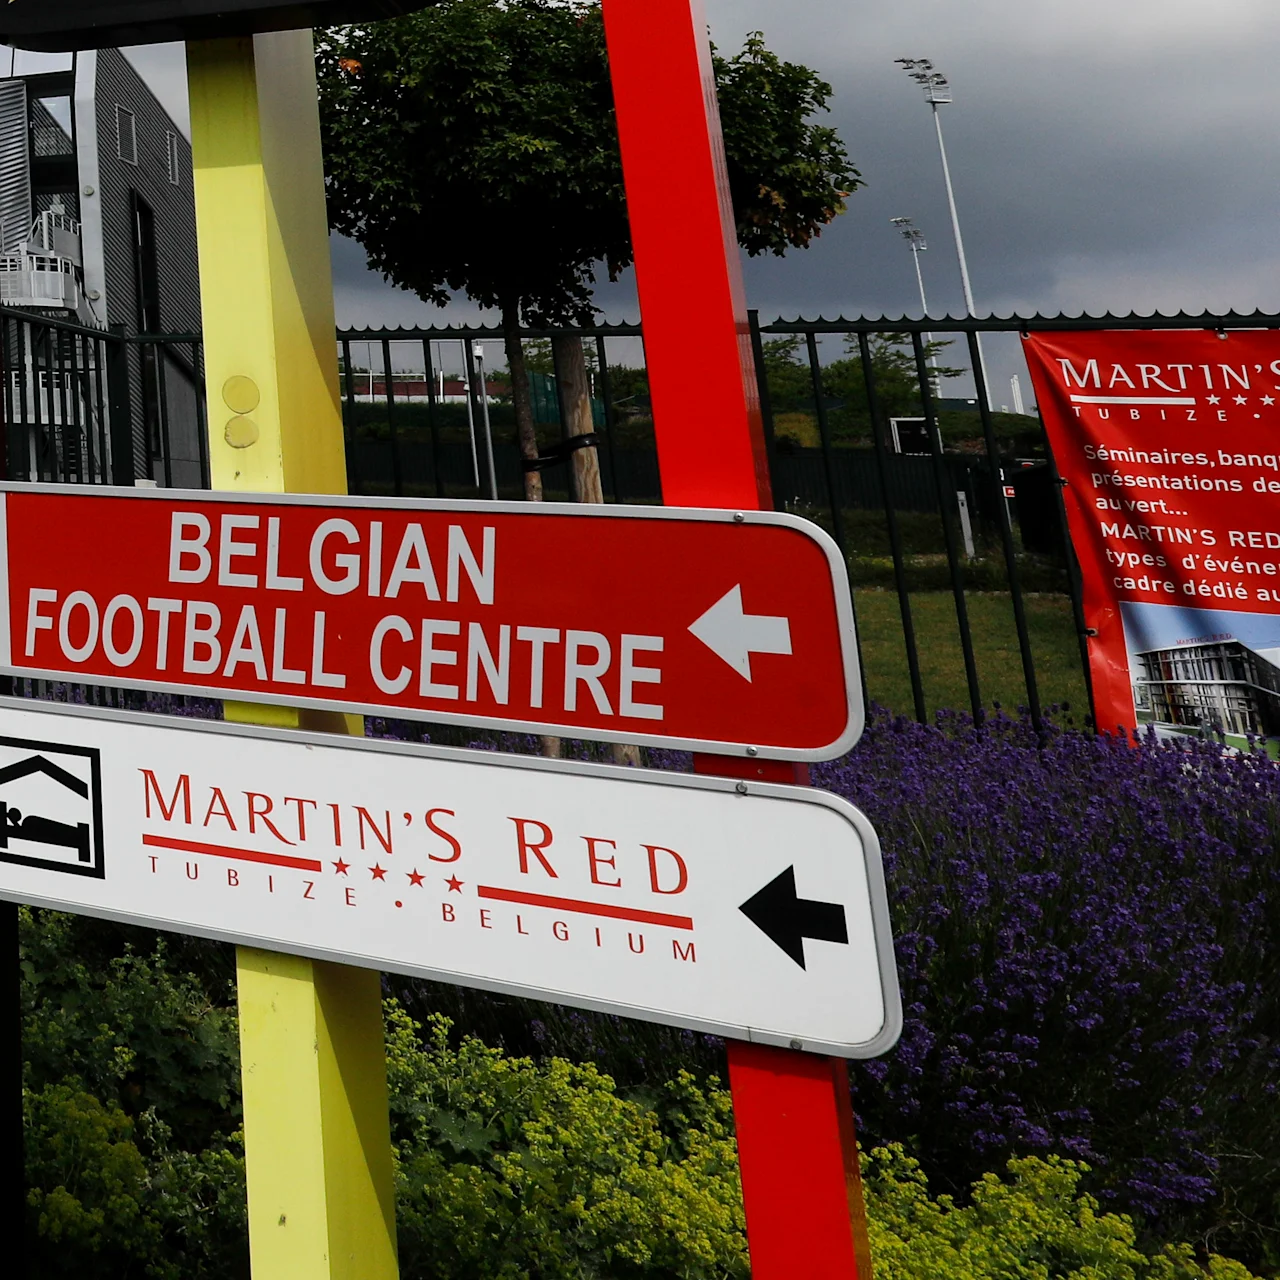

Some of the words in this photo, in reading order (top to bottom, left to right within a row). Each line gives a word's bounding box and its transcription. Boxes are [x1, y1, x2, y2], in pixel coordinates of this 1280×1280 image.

[1072, 406, 1228, 422] TUBIZE
[1083, 443, 1216, 468] Séminaires,
[1217, 449, 1280, 471] banq
[1091, 469, 1243, 492] présentations
[1252, 476, 1280, 493] de
[1095, 496, 1122, 511] au
[1124, 499, 1188, 516] vert...
[1100, 521, 1217, 547] MARTIN'S
[1228, 530, 1280, 549] RED
[168, 511, 496, 605] BELGIAN
[1105, 547, 1167, 569] types
[1182, 553, 1280, 576] d'événe
[1113, 575, 1176, 594] cadre
[1182, 579, 1248, 600] dédié
[25, 587, 346, 689] FOOTBALL
[369, 614, 665, 720] CENTRE
[137, 767, 463, 863] MARTIN'S
[506, 815, 690, 896] RED
[147, 855, 358, 908] TUBIZE
[441, 902, 697, 964] BELGIUM
